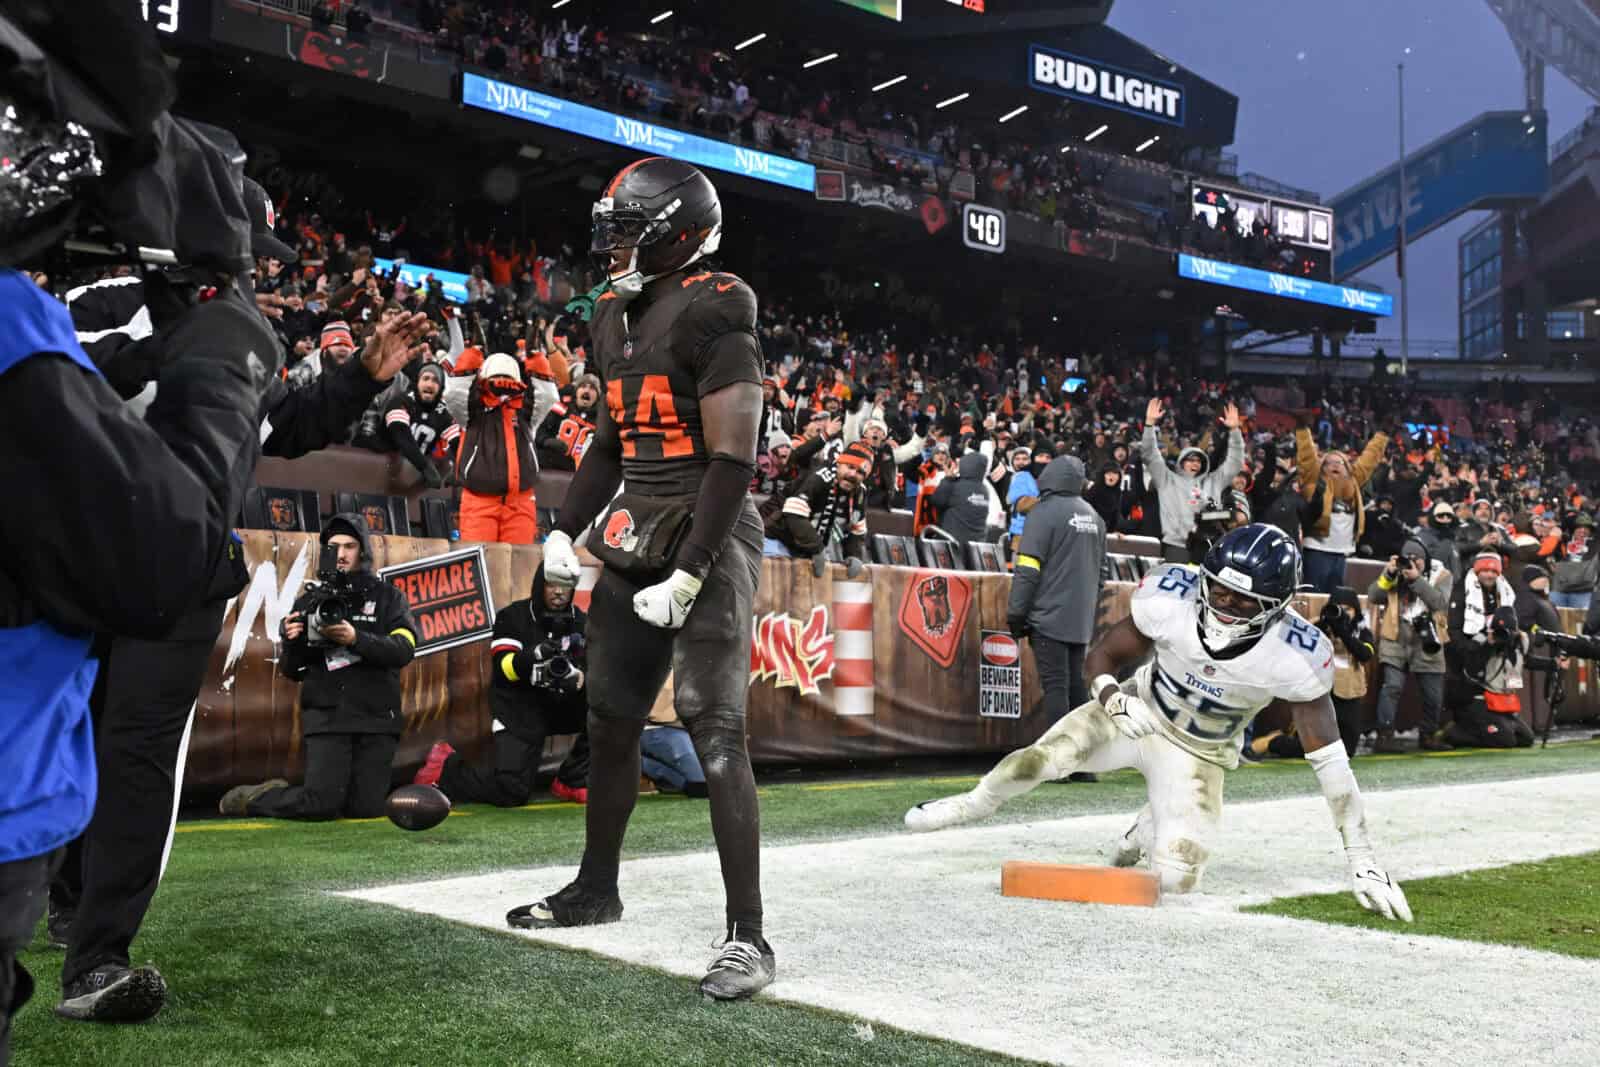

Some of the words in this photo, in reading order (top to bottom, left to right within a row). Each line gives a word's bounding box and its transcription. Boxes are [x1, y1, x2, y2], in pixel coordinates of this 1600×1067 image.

[486, 80, 528, 112] NJM
[1034, 52, 1097, 94] BUD
[1100, 71, 1181, 117] LIGHT
[614, 116, 654, 145] NJM
[734, 146, 769, 175] NJM
[969, 211, 1000, 246] 40
[1191, 256, 1217, 278] NJM
[1268, 272, 1295, 295] NJM
[1341, 286, 1366, 308] NJM
[420, 599, 486, 641] DAWGS
[1284, 617, 1321, 653] 25
[981, 667, 1019, 688] BEWARE
[981, 690, 992, 713] OF
[994, 691, 1019, 715] DAWG
